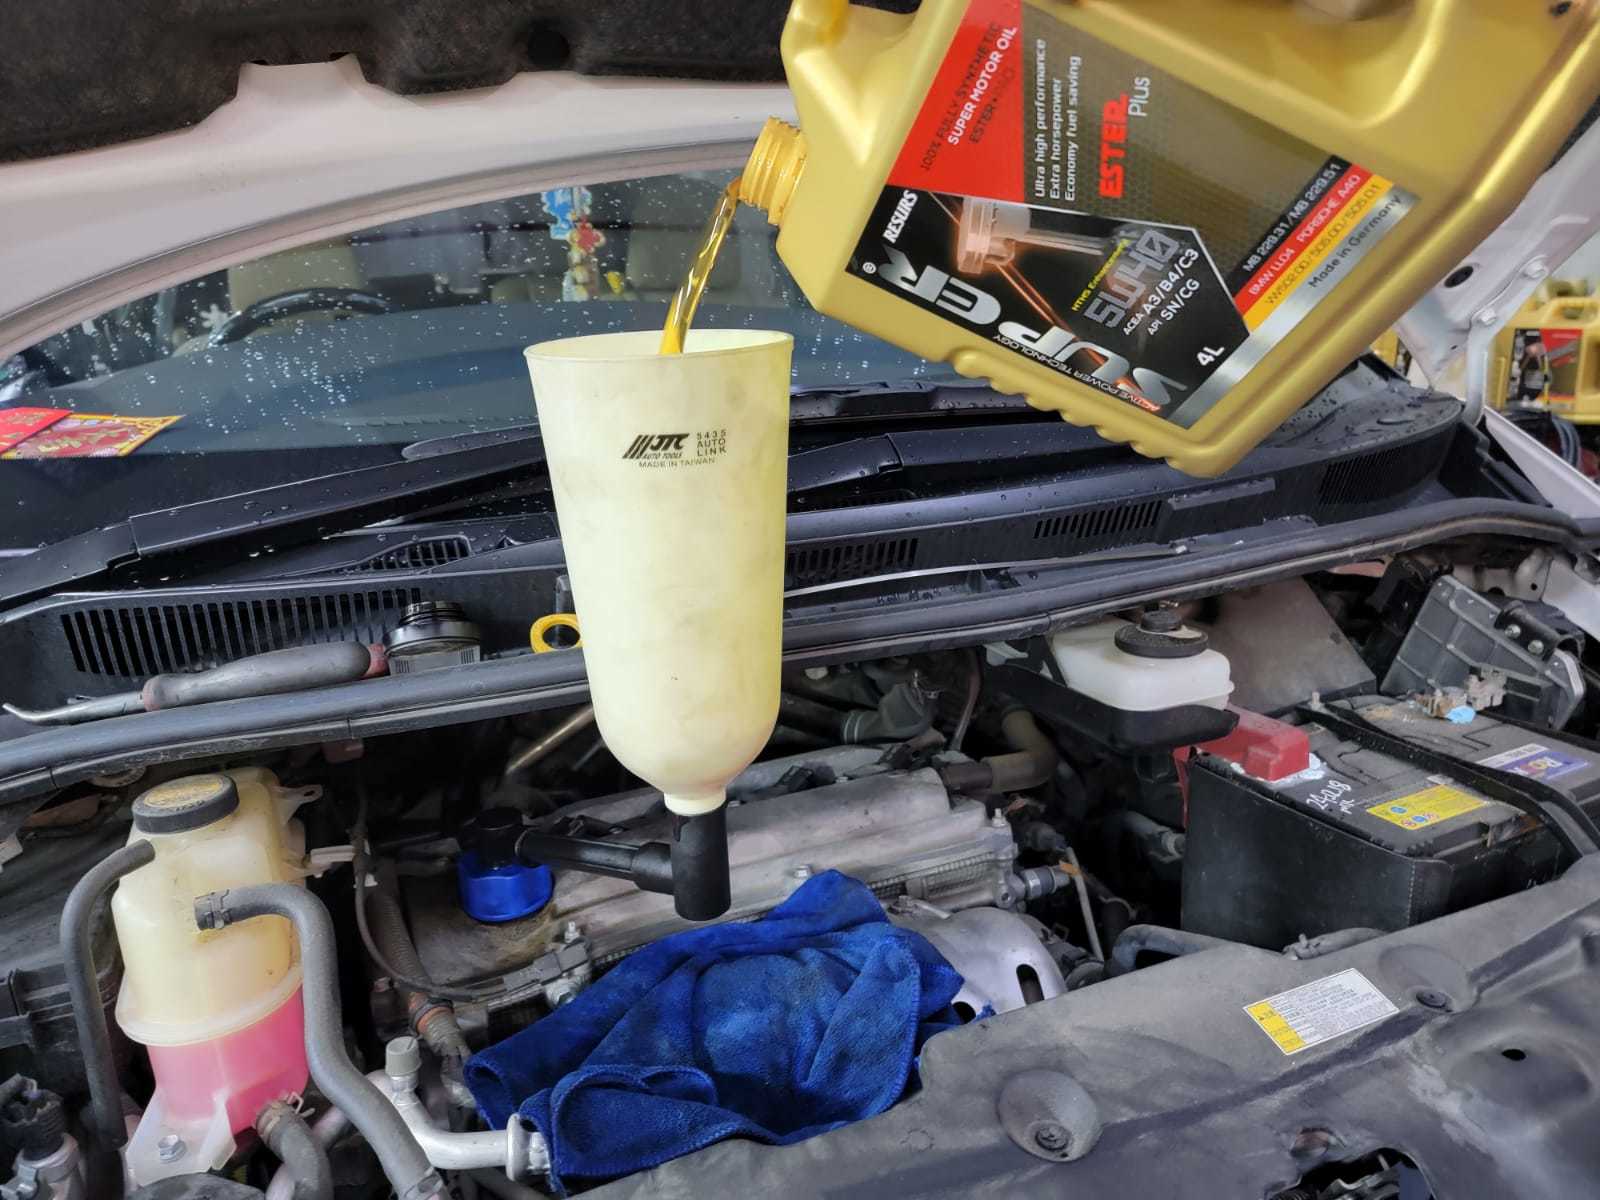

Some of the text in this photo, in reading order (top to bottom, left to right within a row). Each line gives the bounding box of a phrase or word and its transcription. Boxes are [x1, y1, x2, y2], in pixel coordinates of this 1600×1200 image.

[947, 27, 1018, 145] SUPER MOTOR OIL
[1127, 76, 1151, 117] Plus
[936, 99, 958, 138] FULLY
[969, 103, 996, 144] ESTER
[1035, 38, 1048, 198] Ultra high performance
[1050, 78, 1064, 200] Extra horsepower
[1065, 55, 1083, 201] Economy fuel saving
[1099, 90, 1129, 198] ESTER
[882, 189, 919, 244] RESURS
[1248, 270, 1274, 295] BMW
[1296, 198, 1340, 243] PORSCHE
[1338, 174, 1361, 199] A40
[1308, 195, 1401, 288] Made in Germany
[1123, 248, 1199, 336] ACEA A3/B4/C3
[1242, 254, 1262, 273] MB
[1147, 278, 1200, 336] API SN/CG
[993, 335, 1161, 412] ACTIVE POWER TECHNOLOGY
[1196, 346, 1225, 366] 4L
[639, 458, 716, 468] MADE IN TAIWAN
[696, 438, 727, 449] AUTO
[696, 446, 727, 457] LINK
